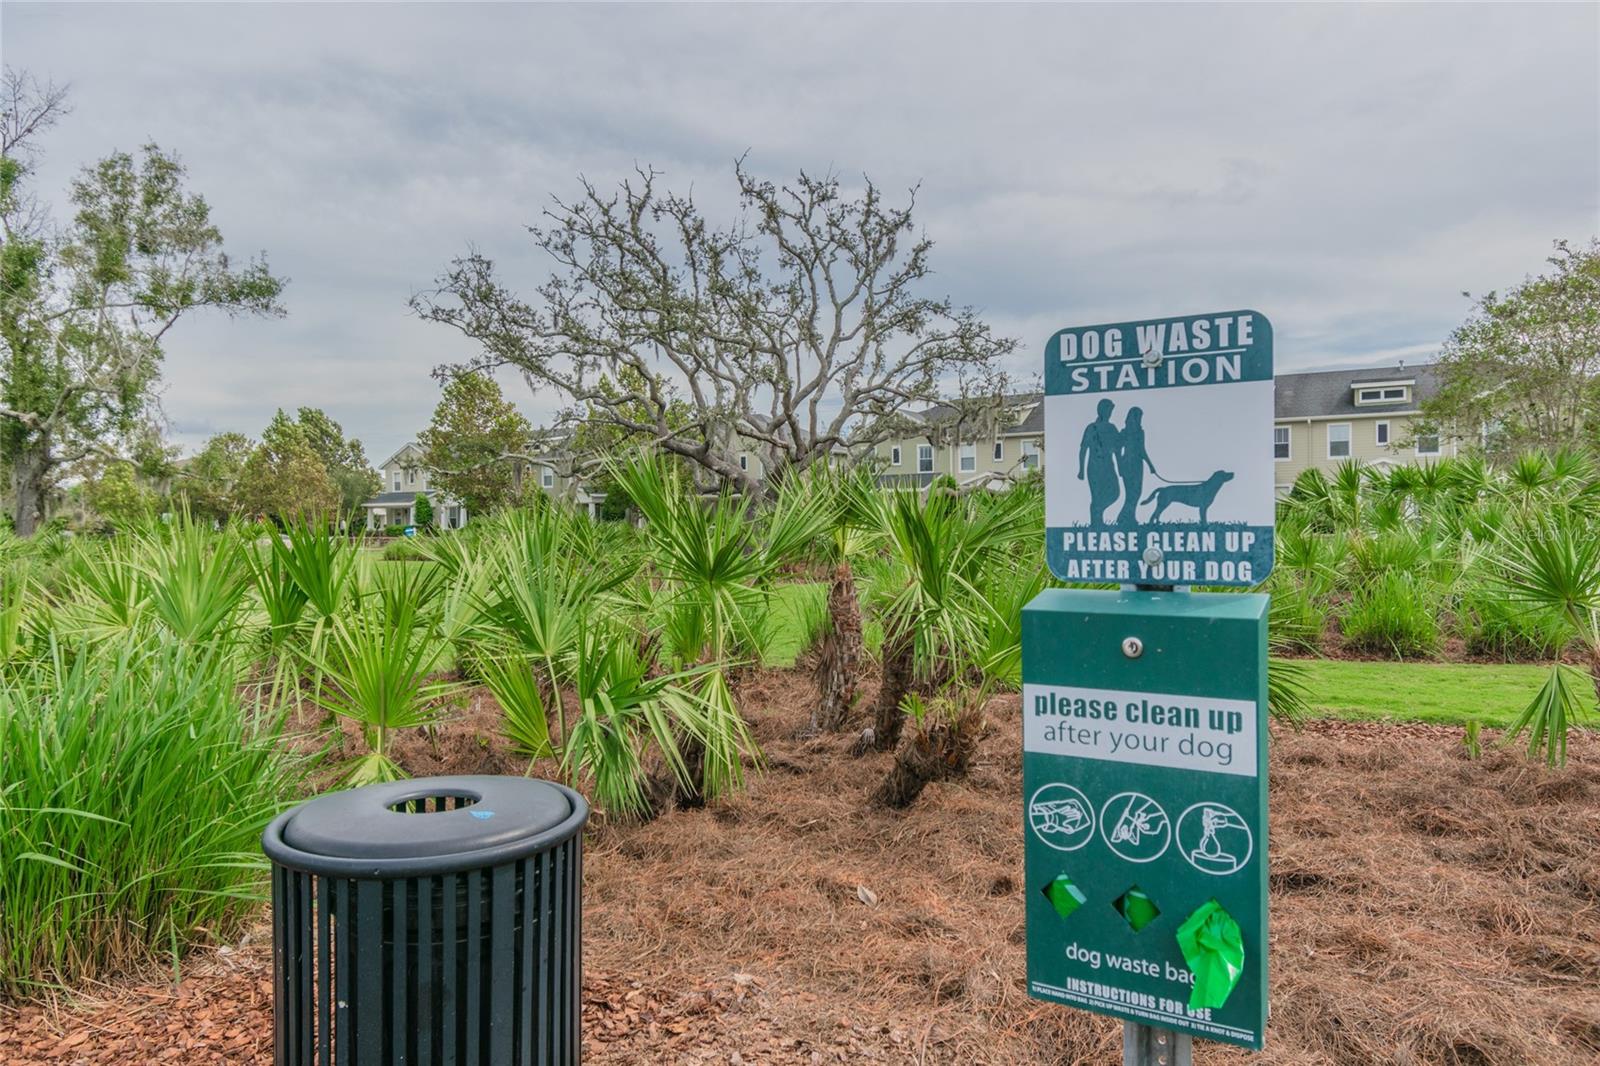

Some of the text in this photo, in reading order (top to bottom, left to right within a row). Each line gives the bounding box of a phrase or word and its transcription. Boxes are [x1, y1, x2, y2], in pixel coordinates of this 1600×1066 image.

[1060, 315, 1254, 361] DOG WASTE
[1071, 354, 1241, 392] STATION
[1063, 531, 1256, 552] PLEASE CLEAN UP
[1067, 559, 1252, 582] AFTER YOUR DOG
[1035, 692, 1243, 735] please clean up
[1043, 720, 1233, 766] after your dog
[1065, 942, 1101, 969] dog
[1106, 954, 1160, 977] waste
[1067, 977, 1212, 1021] INSTRUCTIONS FOR USE
